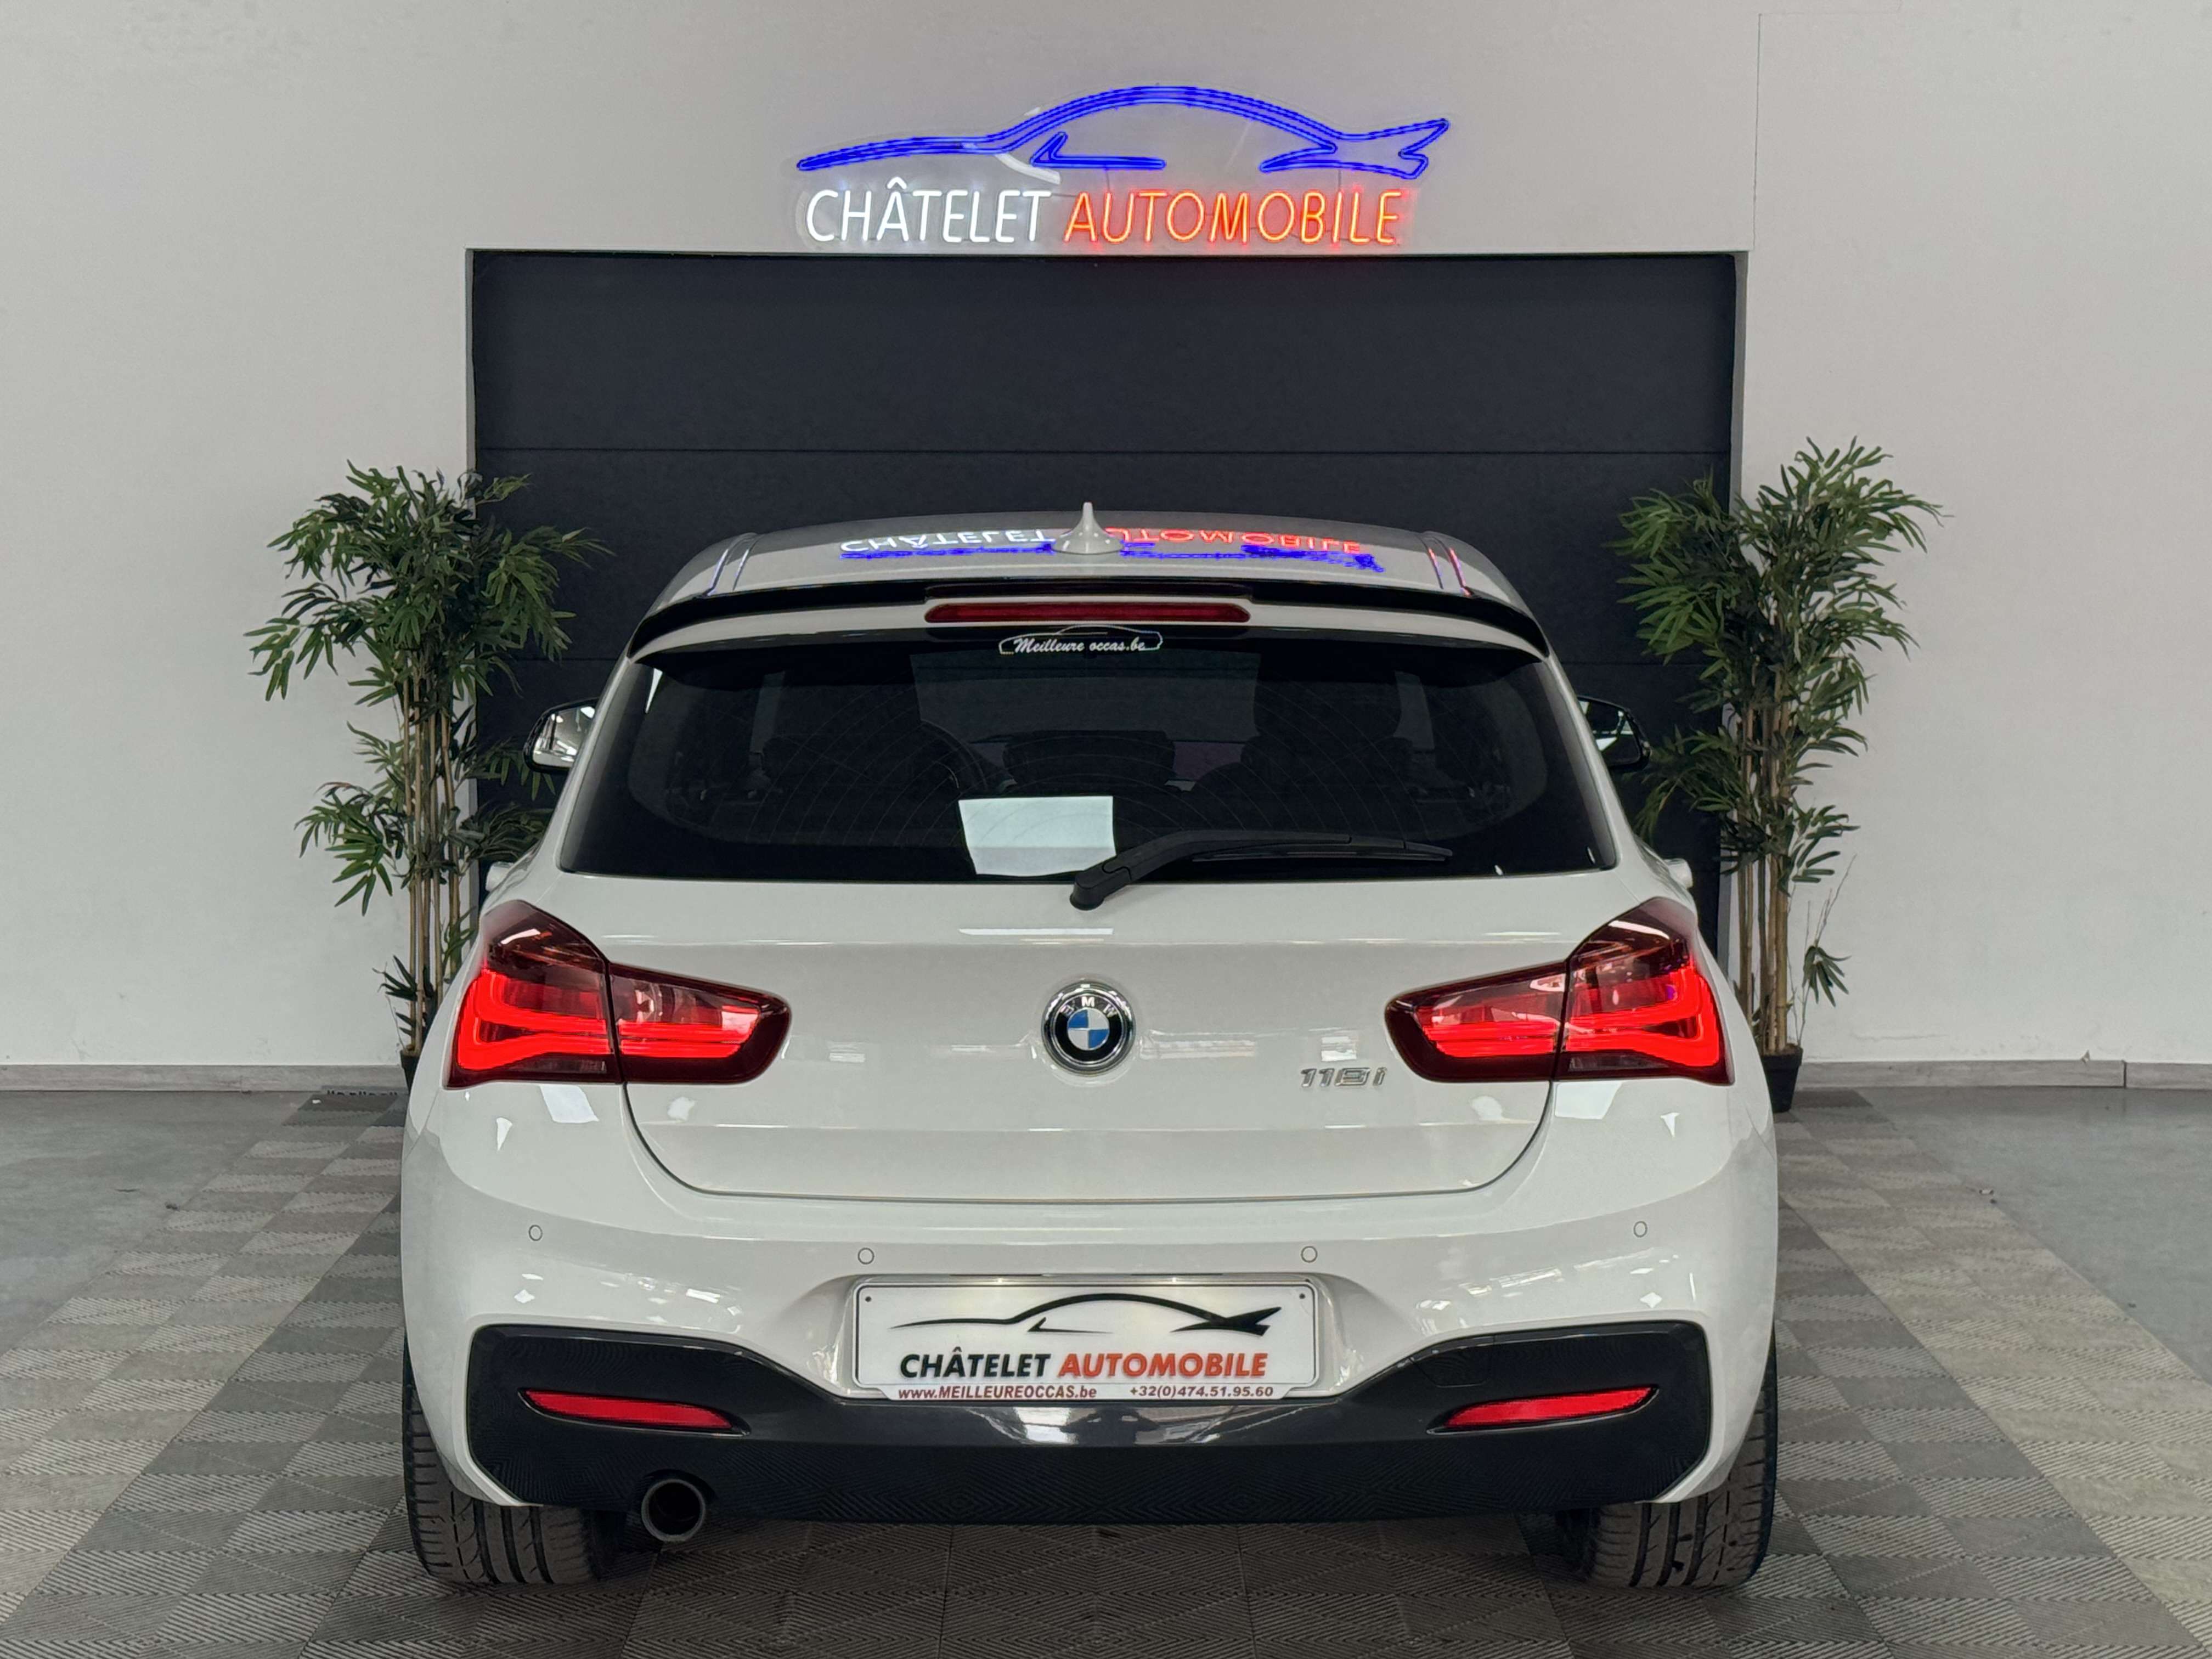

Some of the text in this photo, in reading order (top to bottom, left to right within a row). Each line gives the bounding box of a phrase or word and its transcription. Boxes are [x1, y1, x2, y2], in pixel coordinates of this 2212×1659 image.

[804, 177, 1403, 245] CHÂTELET AUTOMOBILE
[1013, 636, 1146, 653] Meilleure occas.be
[900, 1346, 1269, 1378] CHÂTELET AUTOMOBILE
[898, 1385, 1274, 1399] www.MEILLEUREOCCAS.be +32(0)474.51.95.60
